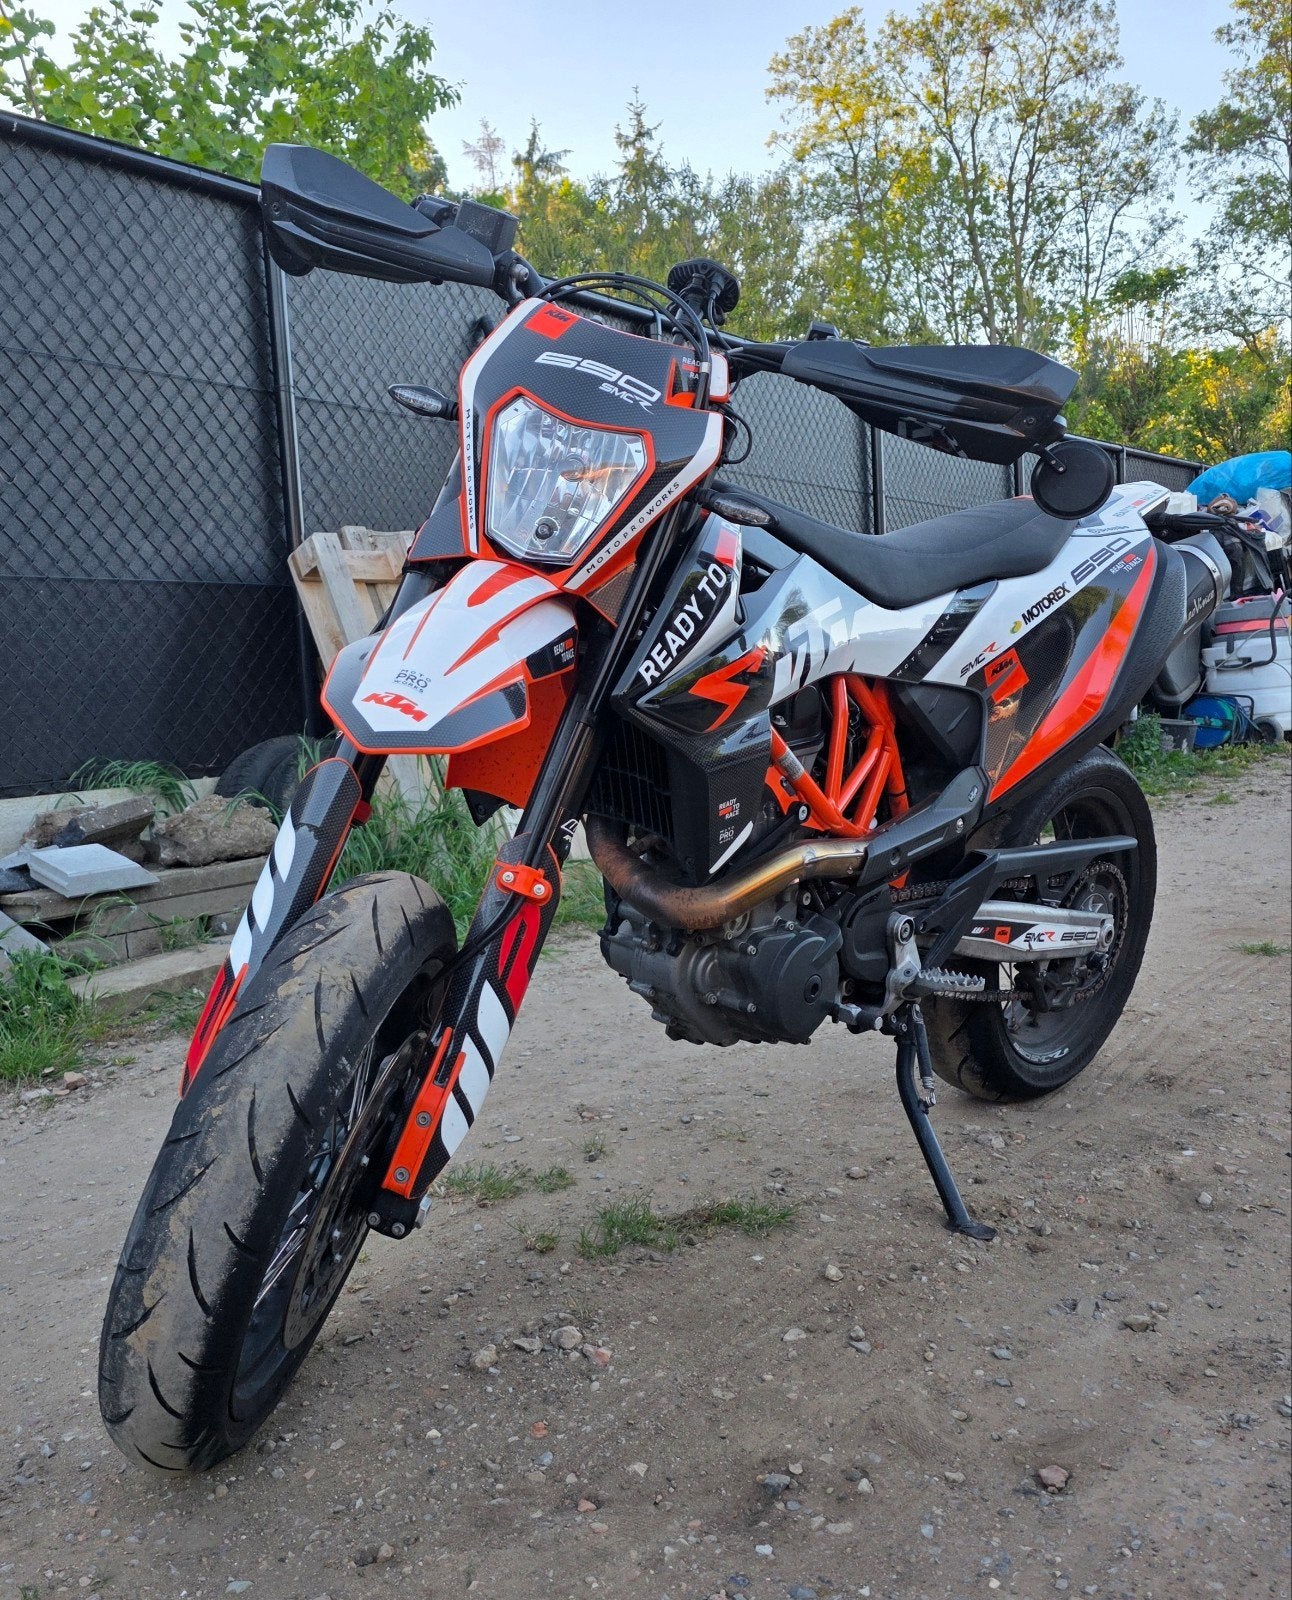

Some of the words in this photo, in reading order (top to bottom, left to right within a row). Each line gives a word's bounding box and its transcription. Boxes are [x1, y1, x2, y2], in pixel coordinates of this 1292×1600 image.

[545, 310, 571, 322] KTM
[682, 356, 701, 367] READ
[534, 352, 662, 402] 690
[689, 371, 700, 379] RA
[586, 482, 679, 574] MOTOPROWORKS
[1070, 537, 1132, 586] 690
[1021, 582, 1071, 625] MOTOREX
[638, 594, 704, 687] READY
[697, 563, 727, 600] TO
[991, 657, 1014, 677] KTM
[395, 672, 428, 688] PRO
[361, 691, 428, 722] KTM
[719, 797, 737, 810] READY
[733, 802, 740, 810] TO
[725, 809, 740, 820] RACE
[719, 829, 735, 841] PRO
[1060, 931, 1098, 942] 690
